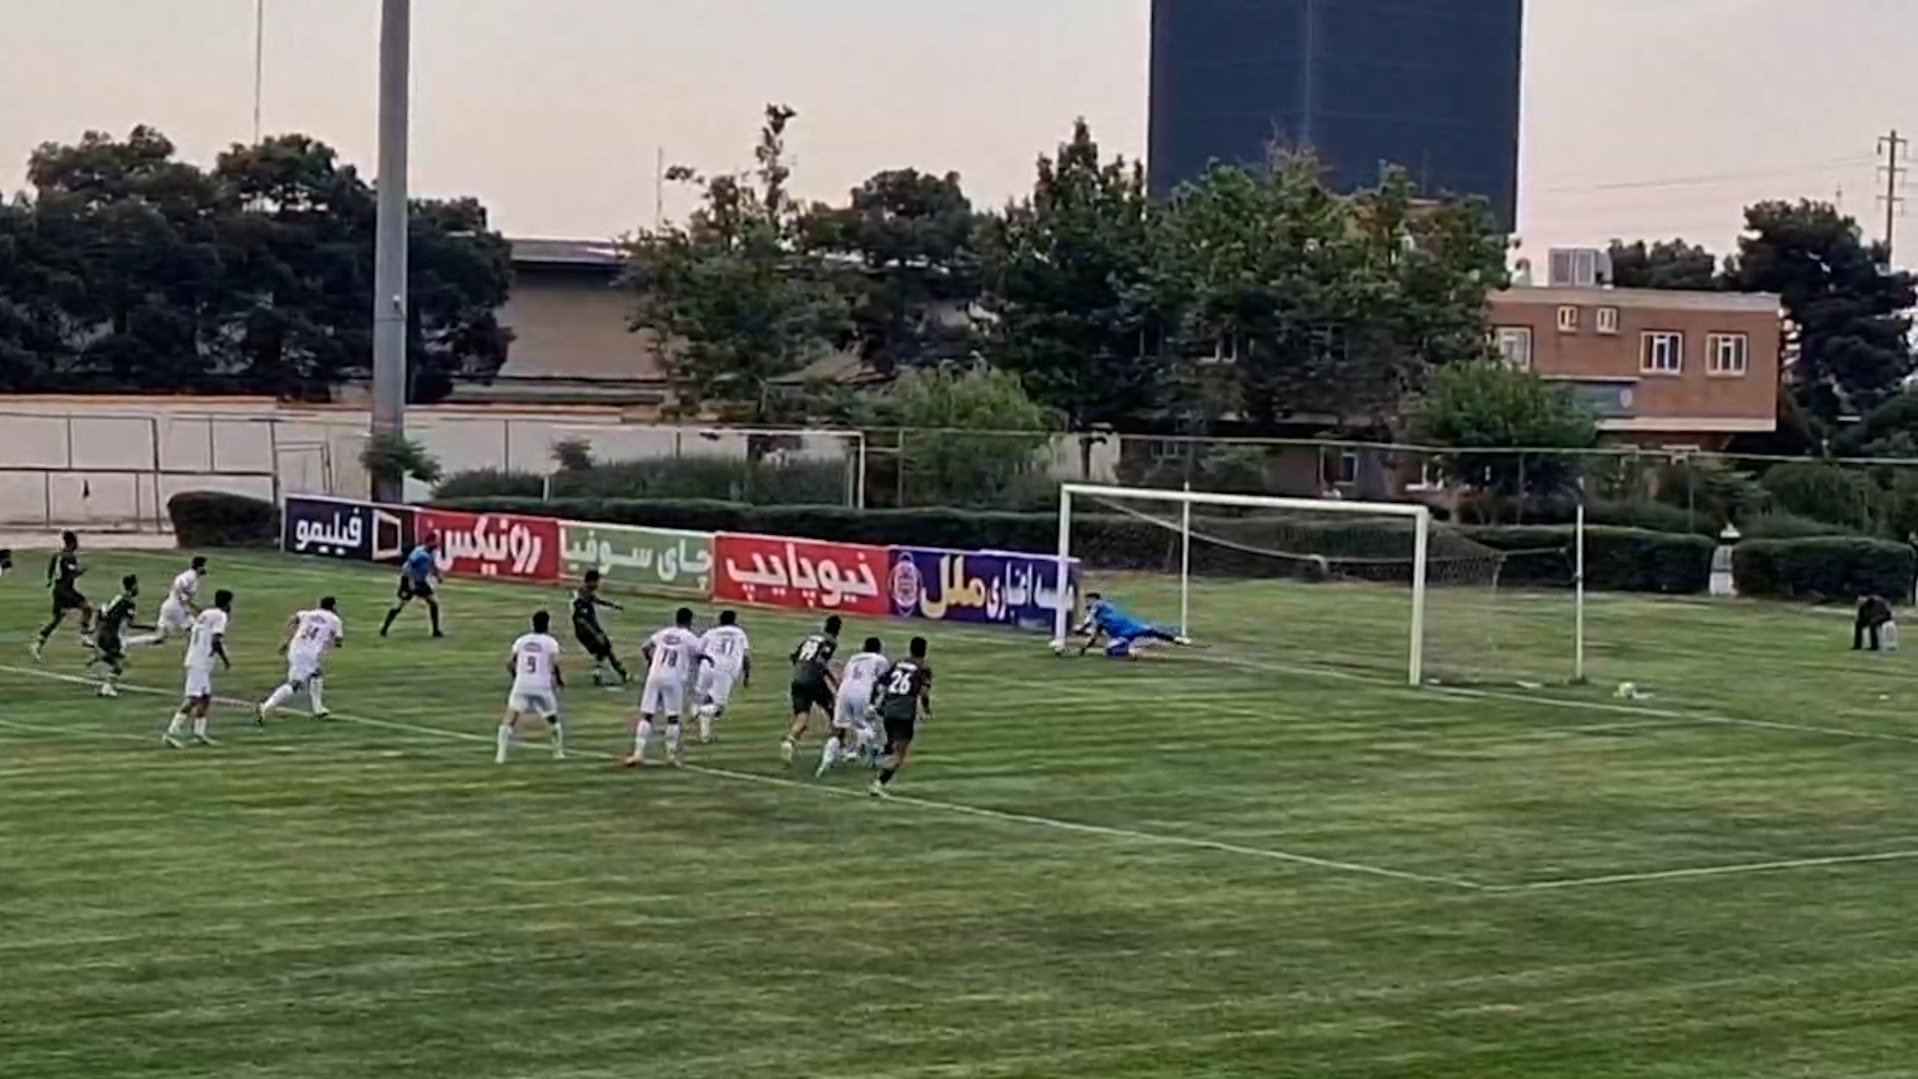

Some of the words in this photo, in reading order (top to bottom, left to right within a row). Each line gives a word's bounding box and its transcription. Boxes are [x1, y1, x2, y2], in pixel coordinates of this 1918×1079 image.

[294, 506, 362, 553] فیلیمو
[433, 516, 542, 574] رونیکس
[558, 527, 652, 575] سوفیا
[657, 538, 713, 591] چای
[725, 543, 879, 608] نیوپایپ
[919, 555, 986, 619] ملل
[887, 670, 912, 695] 26
